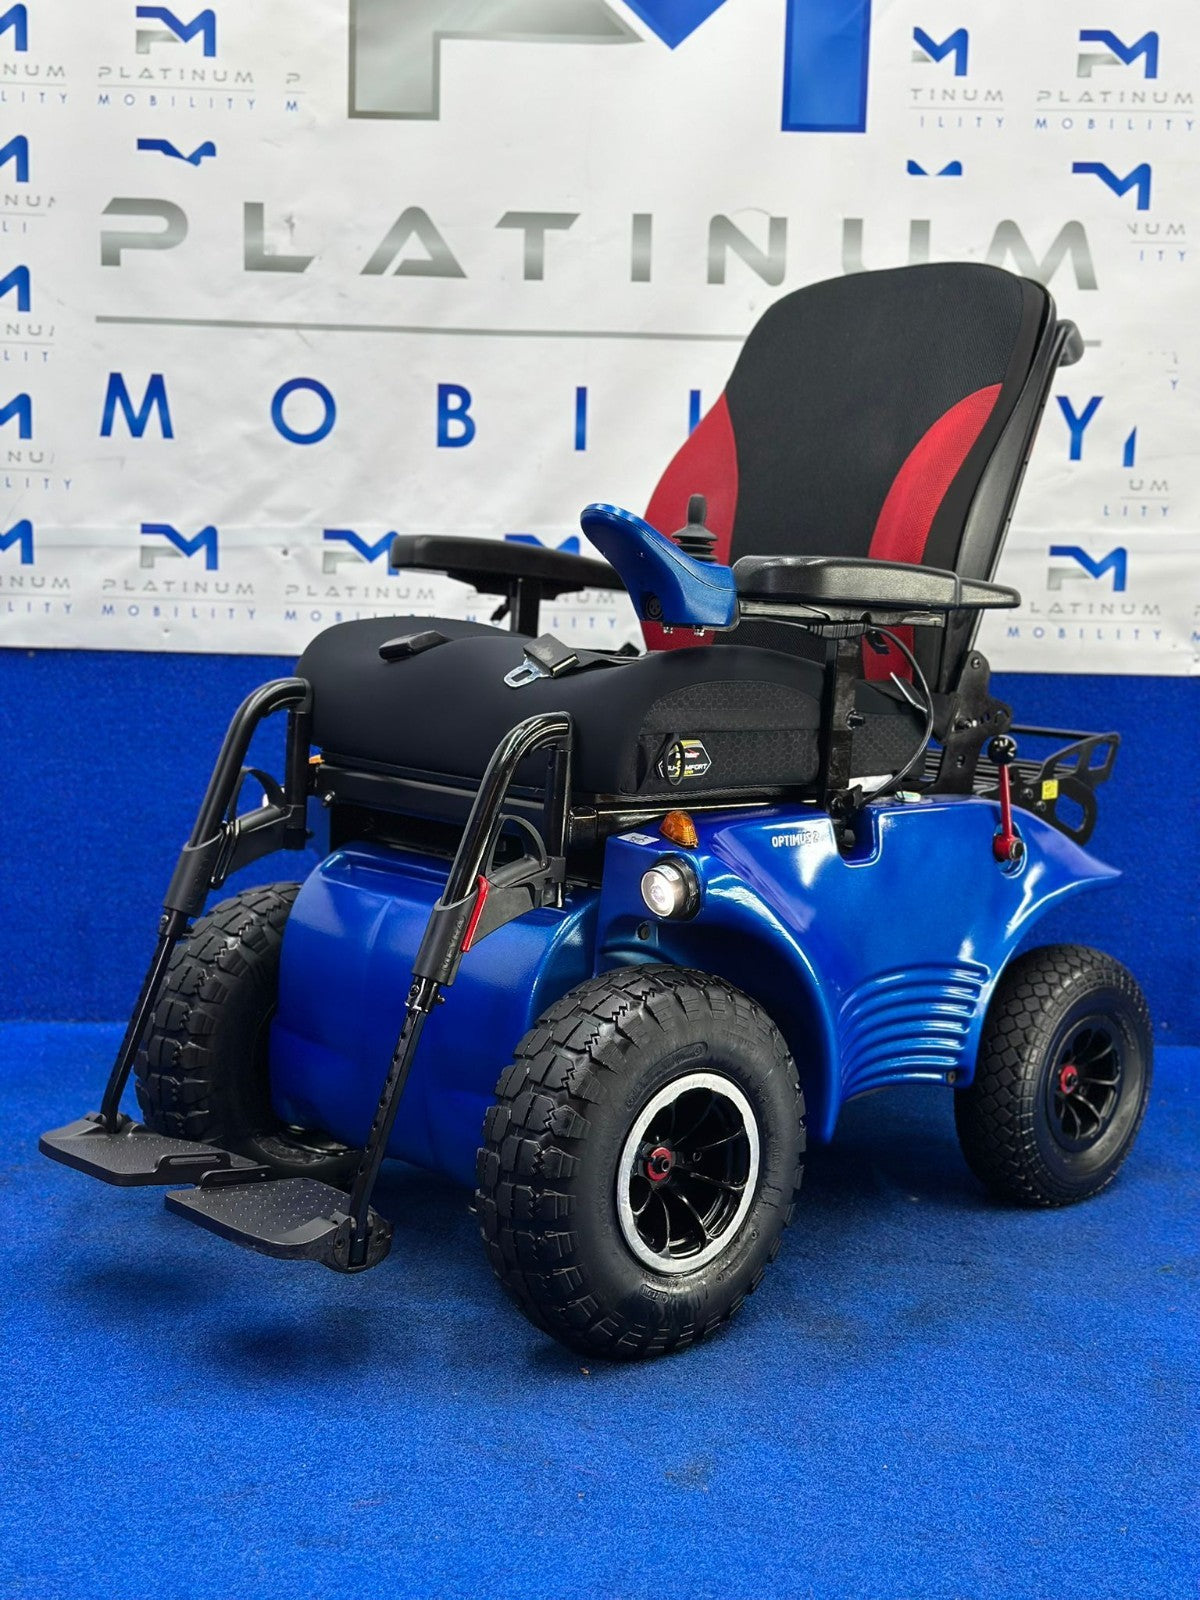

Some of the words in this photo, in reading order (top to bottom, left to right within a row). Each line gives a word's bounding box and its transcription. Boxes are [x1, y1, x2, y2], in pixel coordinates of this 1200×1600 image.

[98, 66, 254, 83] PLATINUM
[98, 94, 255, 110] MOBILITY
[911, 88, 1004, 102] TINUM
[1036, 90, 1194, 104] PLATINUM
[1035, 118, 1194, 131] MOBILITY
[100, 197, 1098, 290] PLATINUM
[102, 578, 255, 595] PLATINUM
[285, 584, 435, 600] PLATINUM
[101, 604, 256, 621] MOBILITY
[1008, 601, 1161, 617] LATINUM
[1007, 626, 1162, 641] MOBILITY
[771, 831, 812, 848] OPTIMUS
